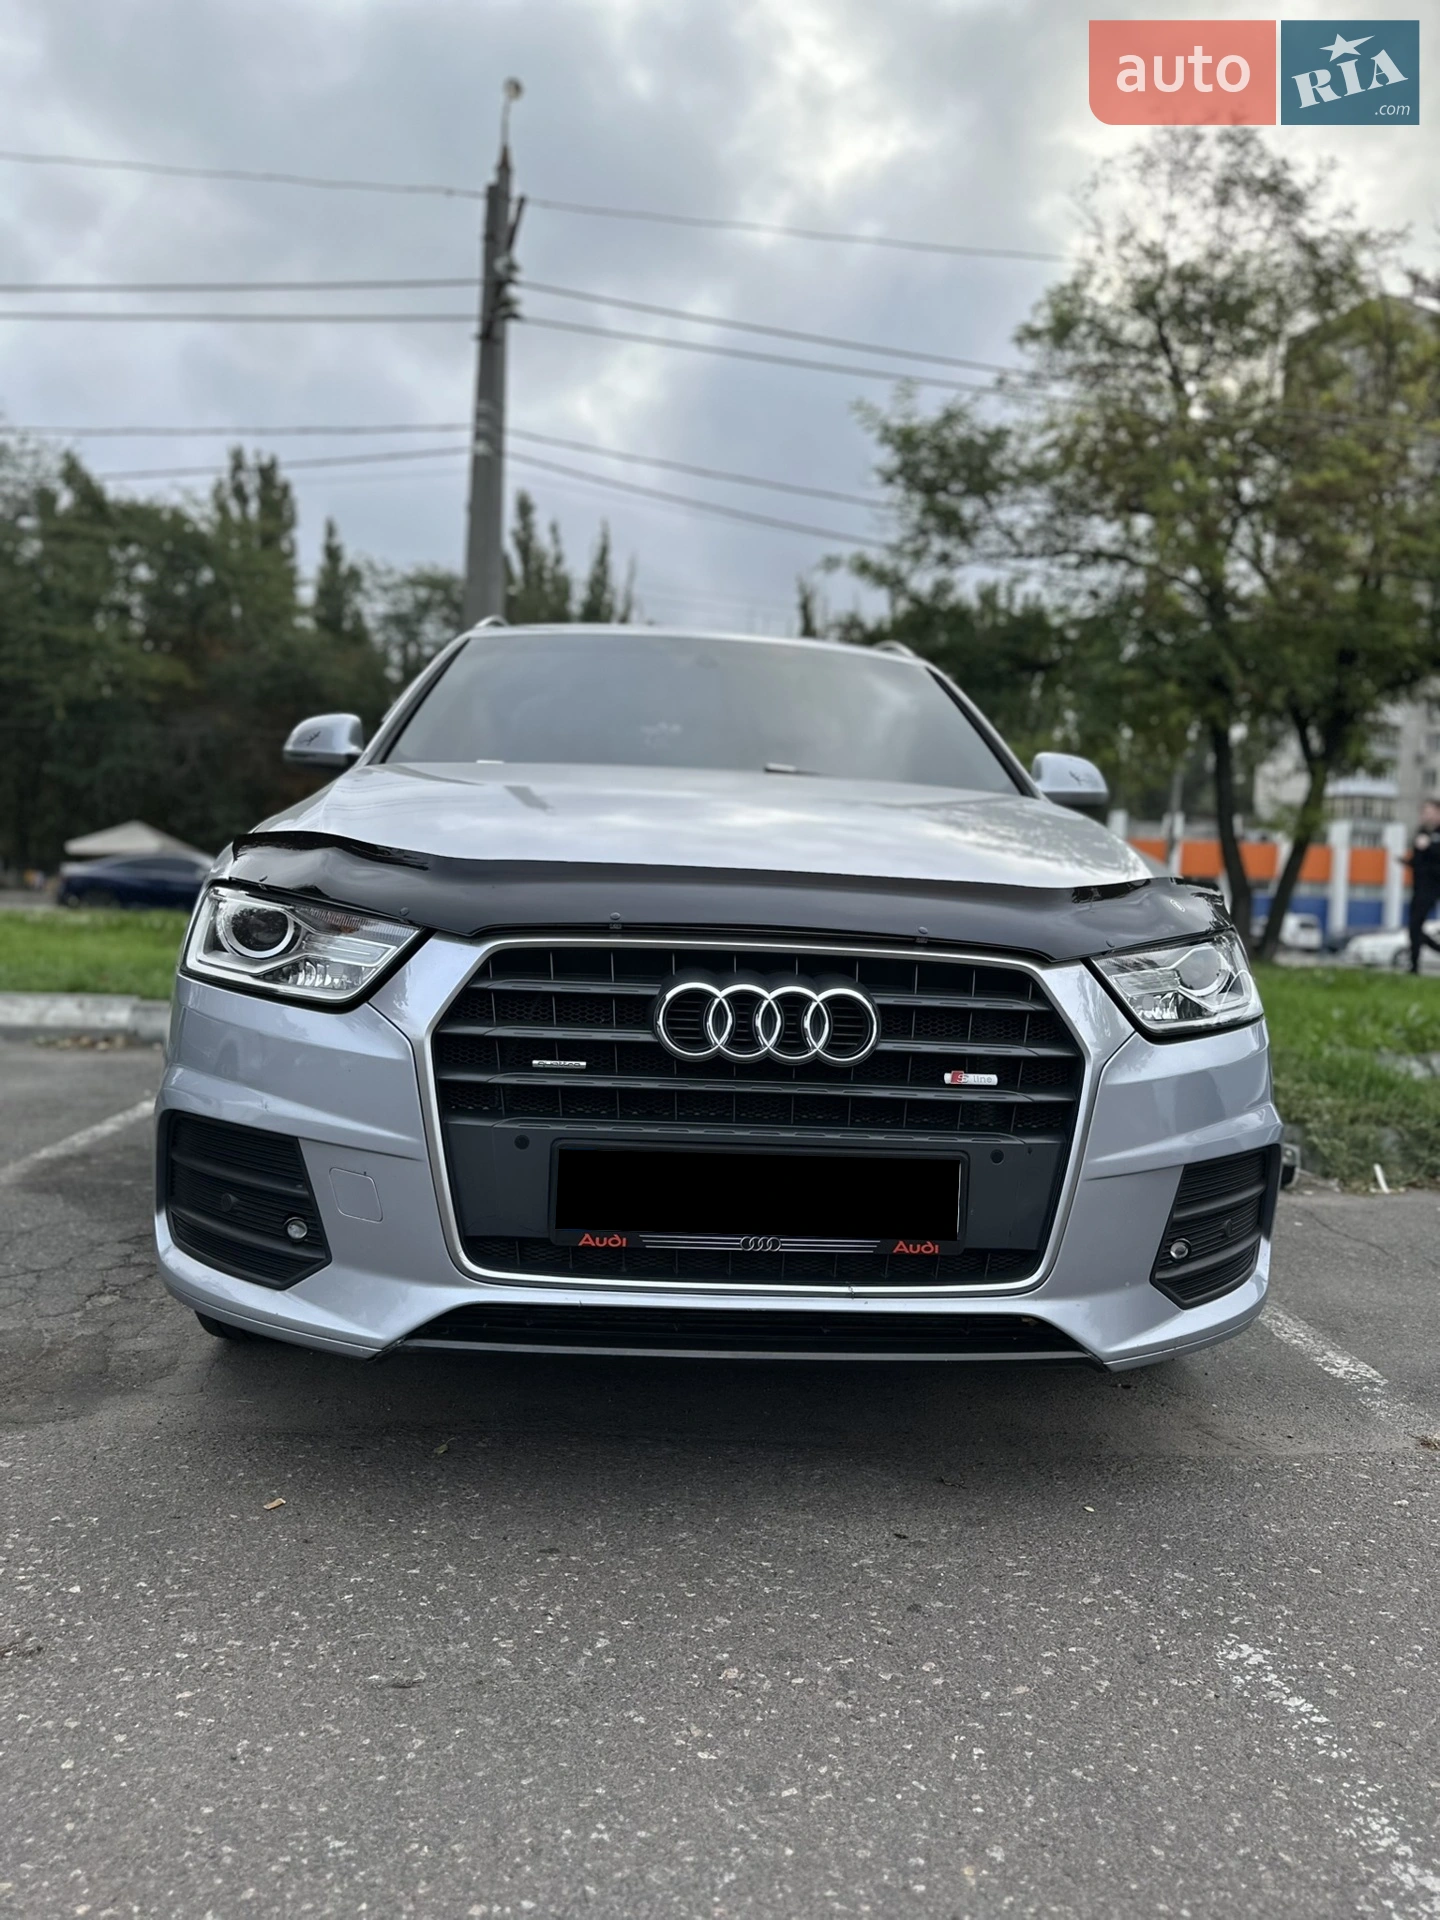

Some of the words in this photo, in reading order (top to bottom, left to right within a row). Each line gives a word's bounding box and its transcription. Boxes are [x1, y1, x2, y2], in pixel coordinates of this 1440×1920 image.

[973, 1074, 993, 1084] line
[578, 1233, 627, 1247] Audi
[893, 1240, 939, 1254] Audi
